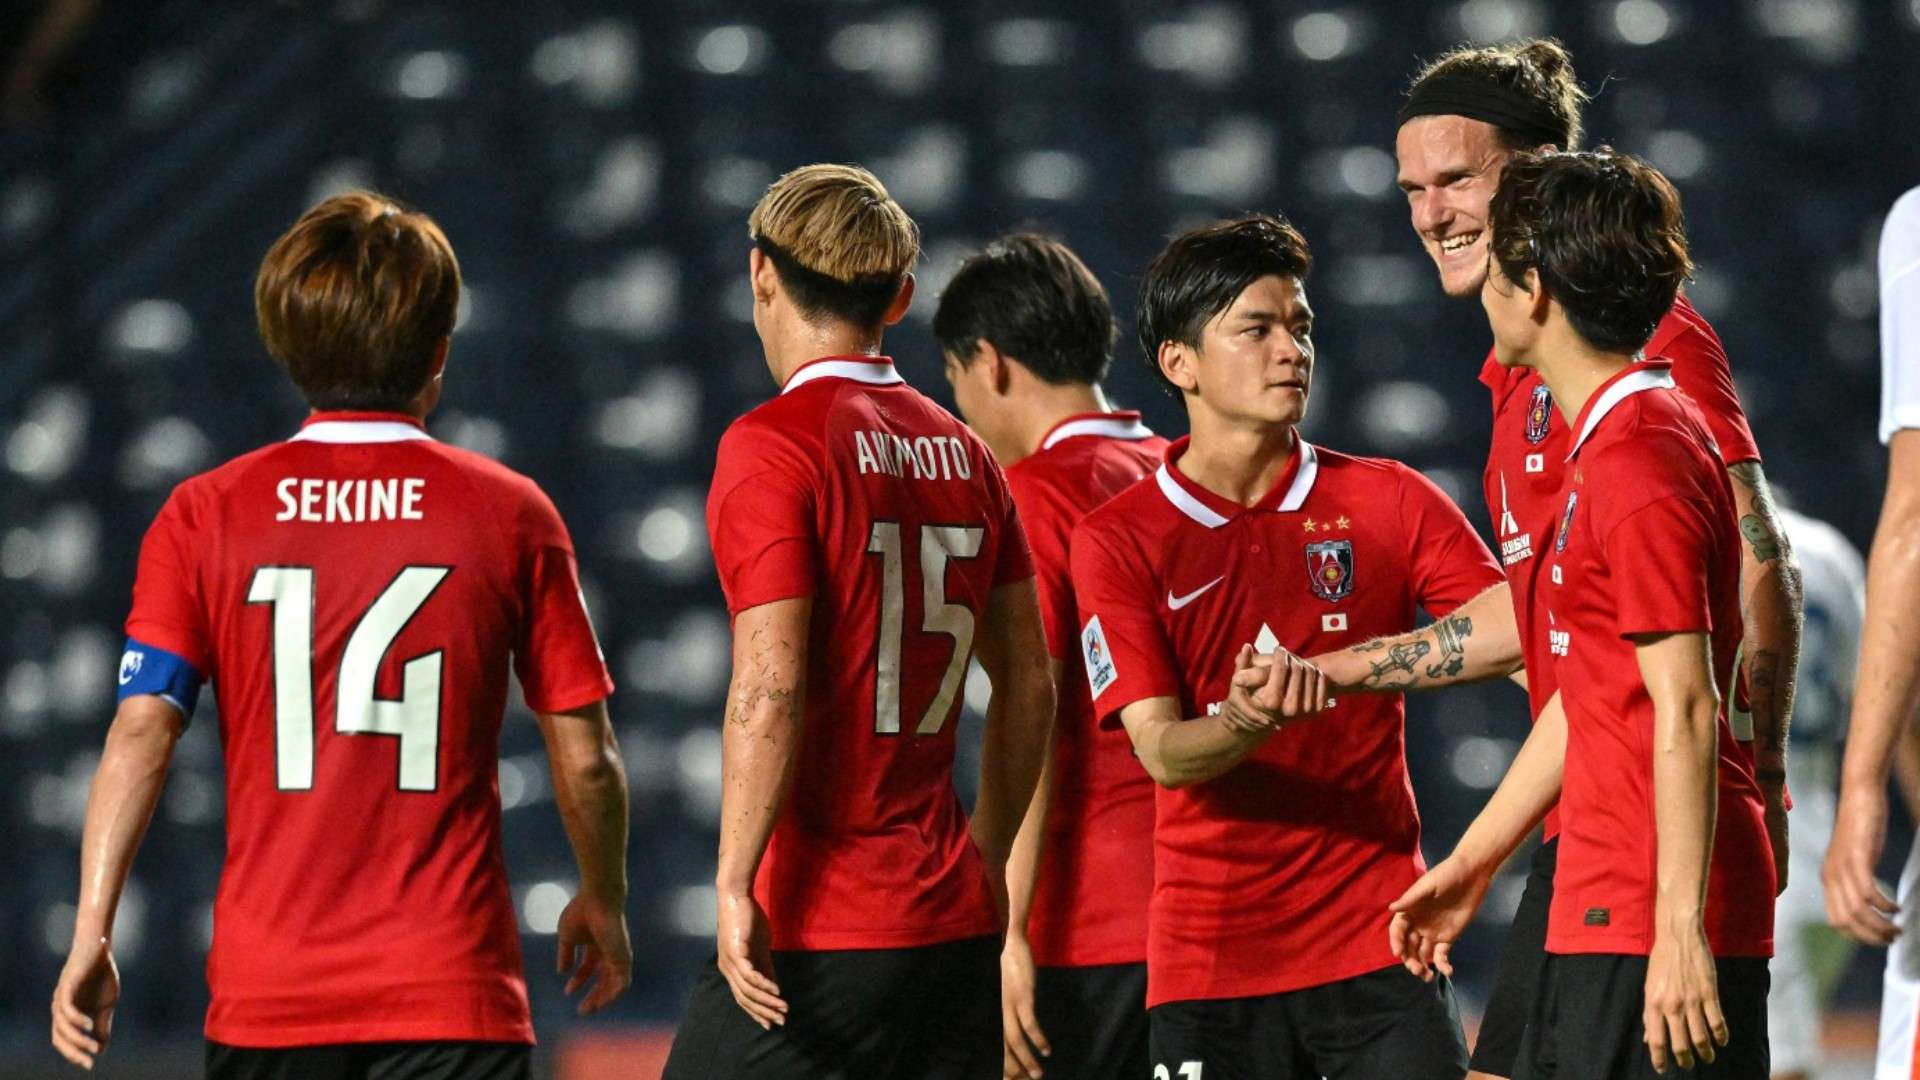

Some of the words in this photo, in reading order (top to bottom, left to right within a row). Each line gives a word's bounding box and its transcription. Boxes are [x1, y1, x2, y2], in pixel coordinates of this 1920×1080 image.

[275, 477, 425, 523] SEKINE
[246, 565, 453, 793] 14
[867, 522, 985, 734] 15
